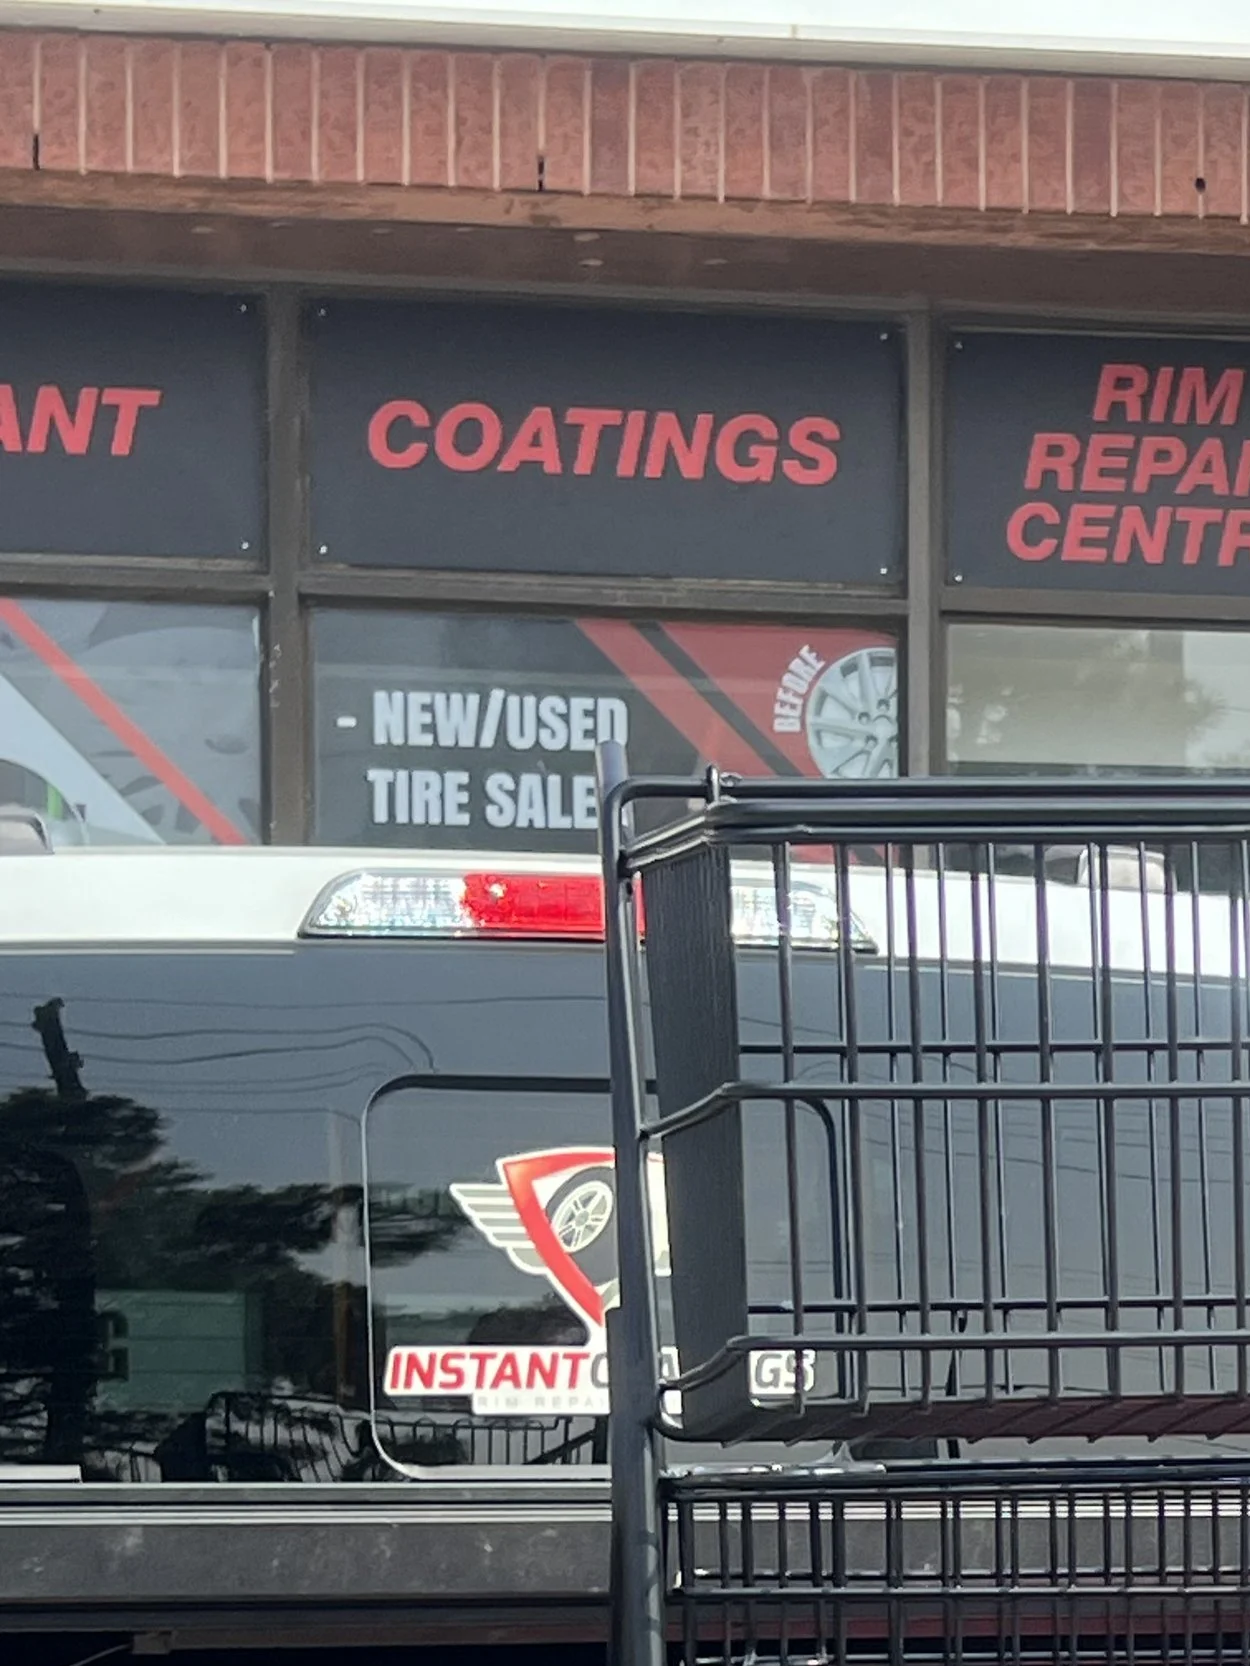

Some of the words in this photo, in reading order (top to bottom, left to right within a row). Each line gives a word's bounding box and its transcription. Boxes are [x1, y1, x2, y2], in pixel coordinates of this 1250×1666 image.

[1093, 364, 1245, 425] RIM
[368, 400, 841, 486] COATINGS
[373, 688, 629, 751] NEW/USED
[772, 643, 826, 734] BEFORE
[367, 768, 471, 826] TIRE
